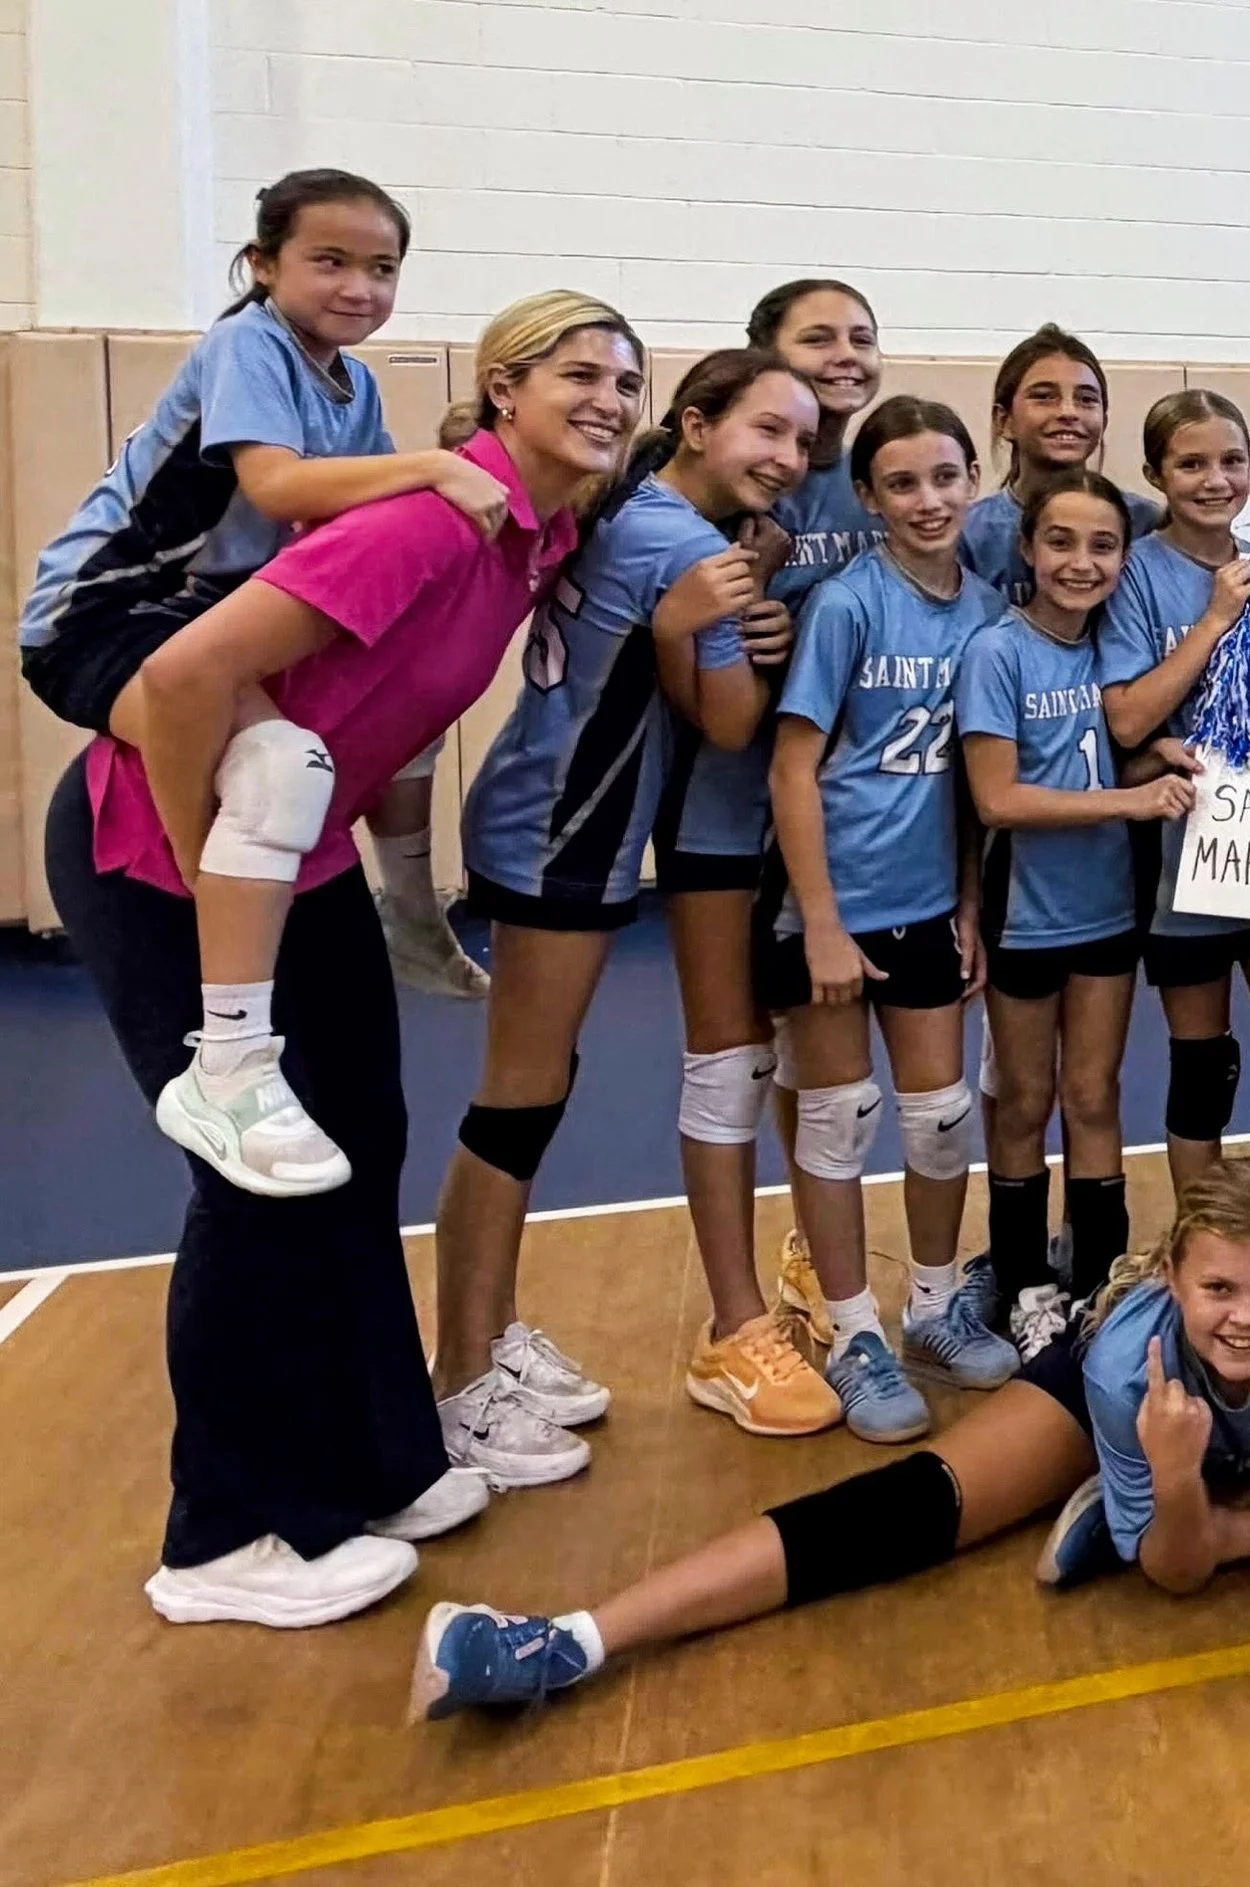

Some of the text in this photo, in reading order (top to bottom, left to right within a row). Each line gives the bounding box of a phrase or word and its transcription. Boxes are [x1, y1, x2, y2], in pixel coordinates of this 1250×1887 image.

[858, 654, 934, 690] SAINT
[877, 699, 954, 776] 22
[1077, 727, 1105, 791] 1
